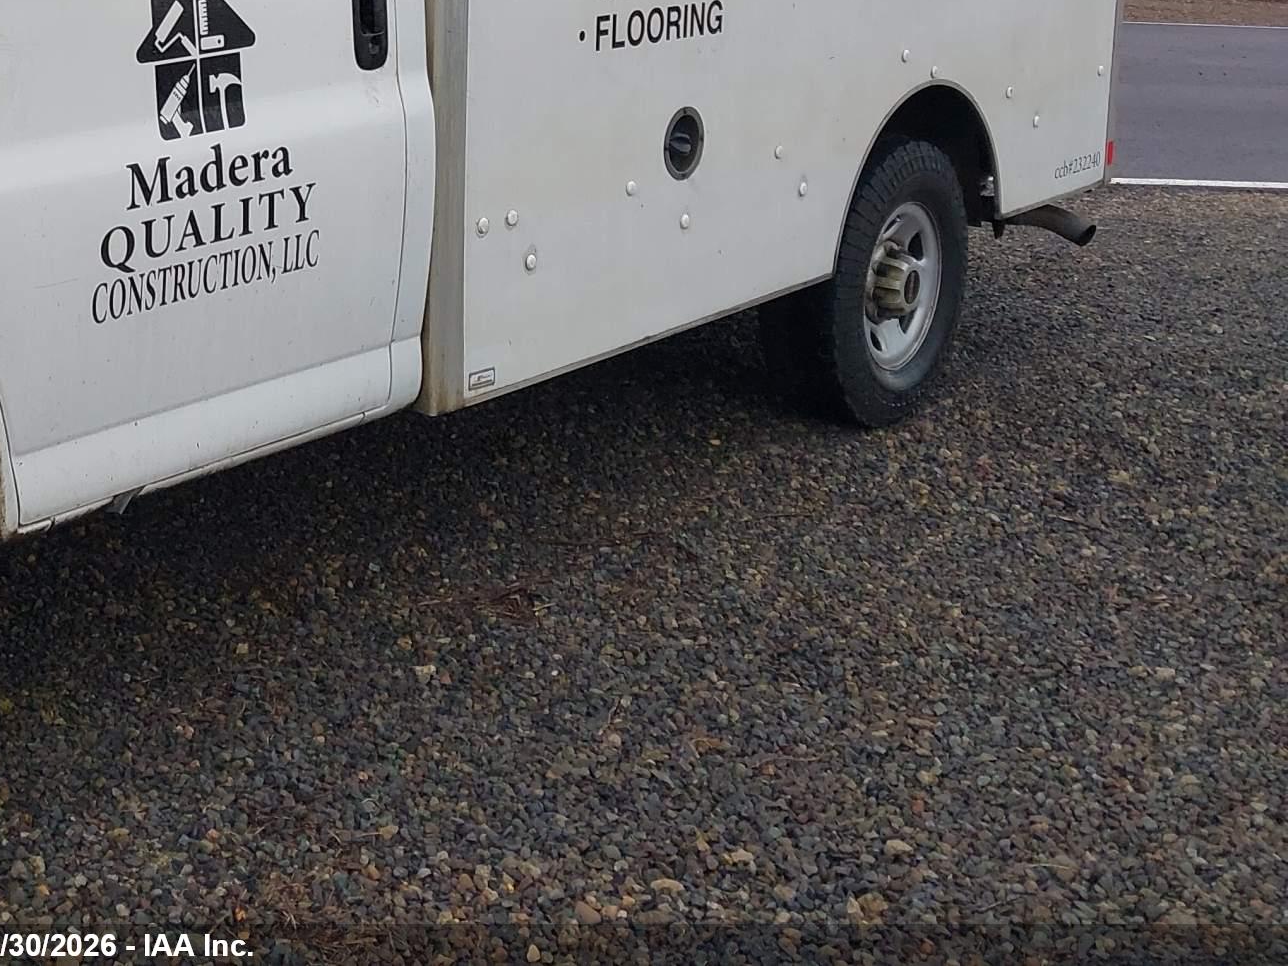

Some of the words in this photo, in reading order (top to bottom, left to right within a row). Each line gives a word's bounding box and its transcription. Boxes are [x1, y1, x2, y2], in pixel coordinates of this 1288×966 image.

[595, 0, 723, 52] FLOORING
[126, 143, 293, 210] Madera
[100, 182, 317, 273] QUALITY
[91, 239, 277, 324] CONSTRUCTION,
[280, 229, 321, 275] LLC
